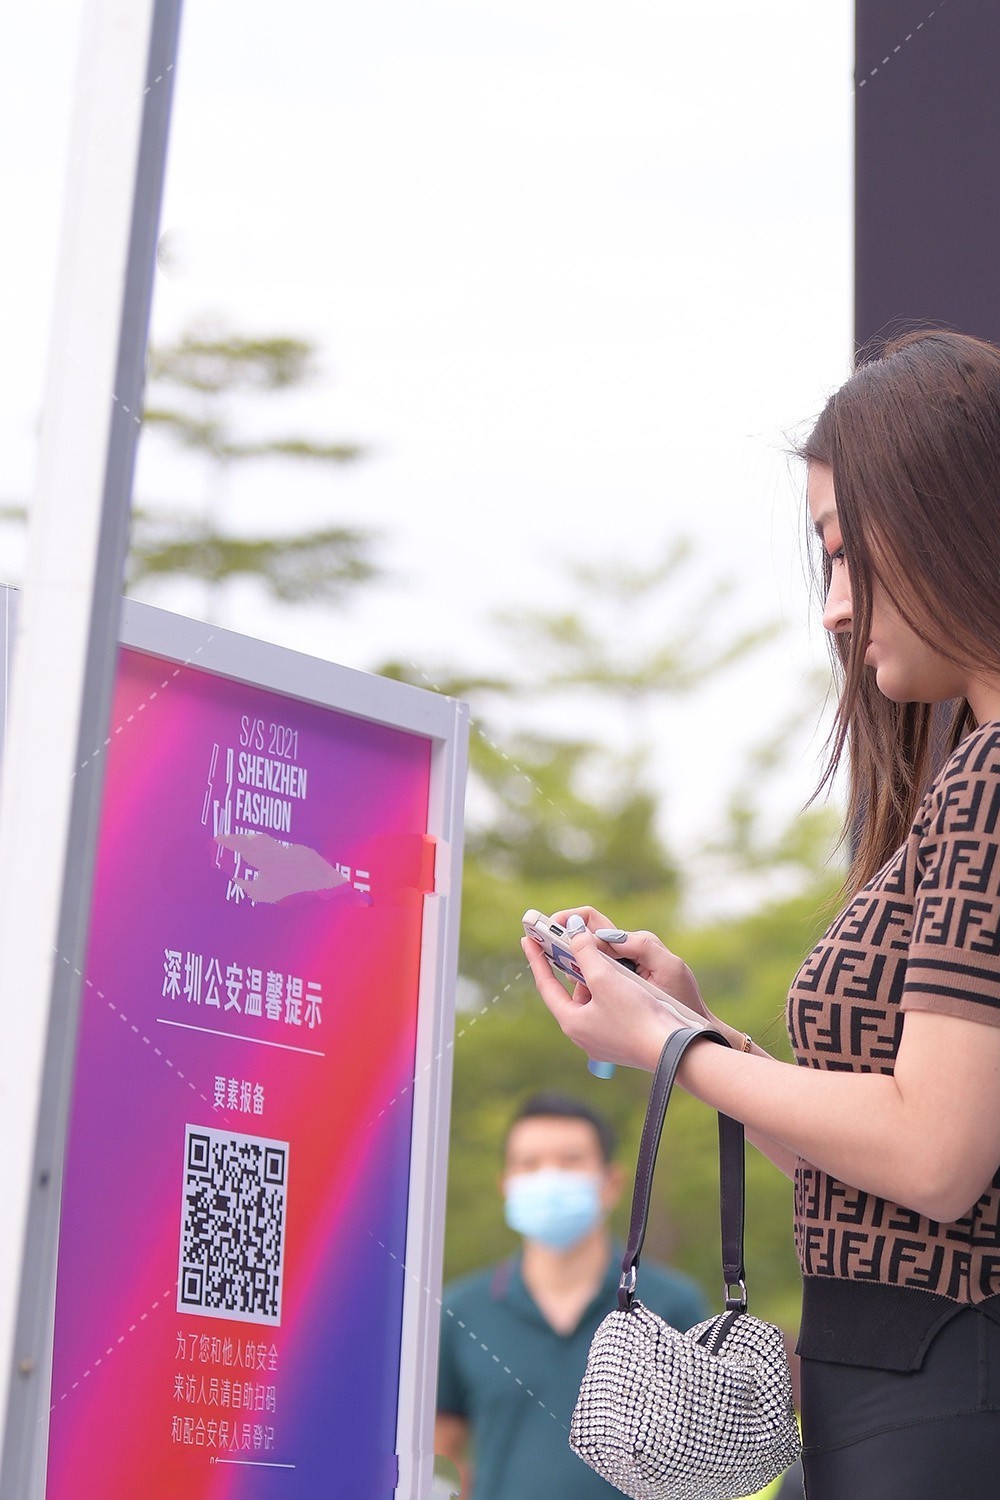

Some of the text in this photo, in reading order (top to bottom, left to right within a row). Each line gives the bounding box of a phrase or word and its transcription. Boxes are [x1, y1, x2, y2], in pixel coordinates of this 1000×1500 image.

[239, 715, 299, 760] S/S 2021
[237, 751, 308, 800] SHENZHEN
[235, 788, 292, 833] FASHION
[161, 948, 323, 1029] 深圳公安温馨提示
[213, 1075, 265, 1115] 要素报备
[174, 1330, 279, 1371] 为了您和他人的安全
[173, 1372, 276, 1413] 来访人员请自助扫码
[171, 1415, 275, 1450] 和配合安保人员登记
